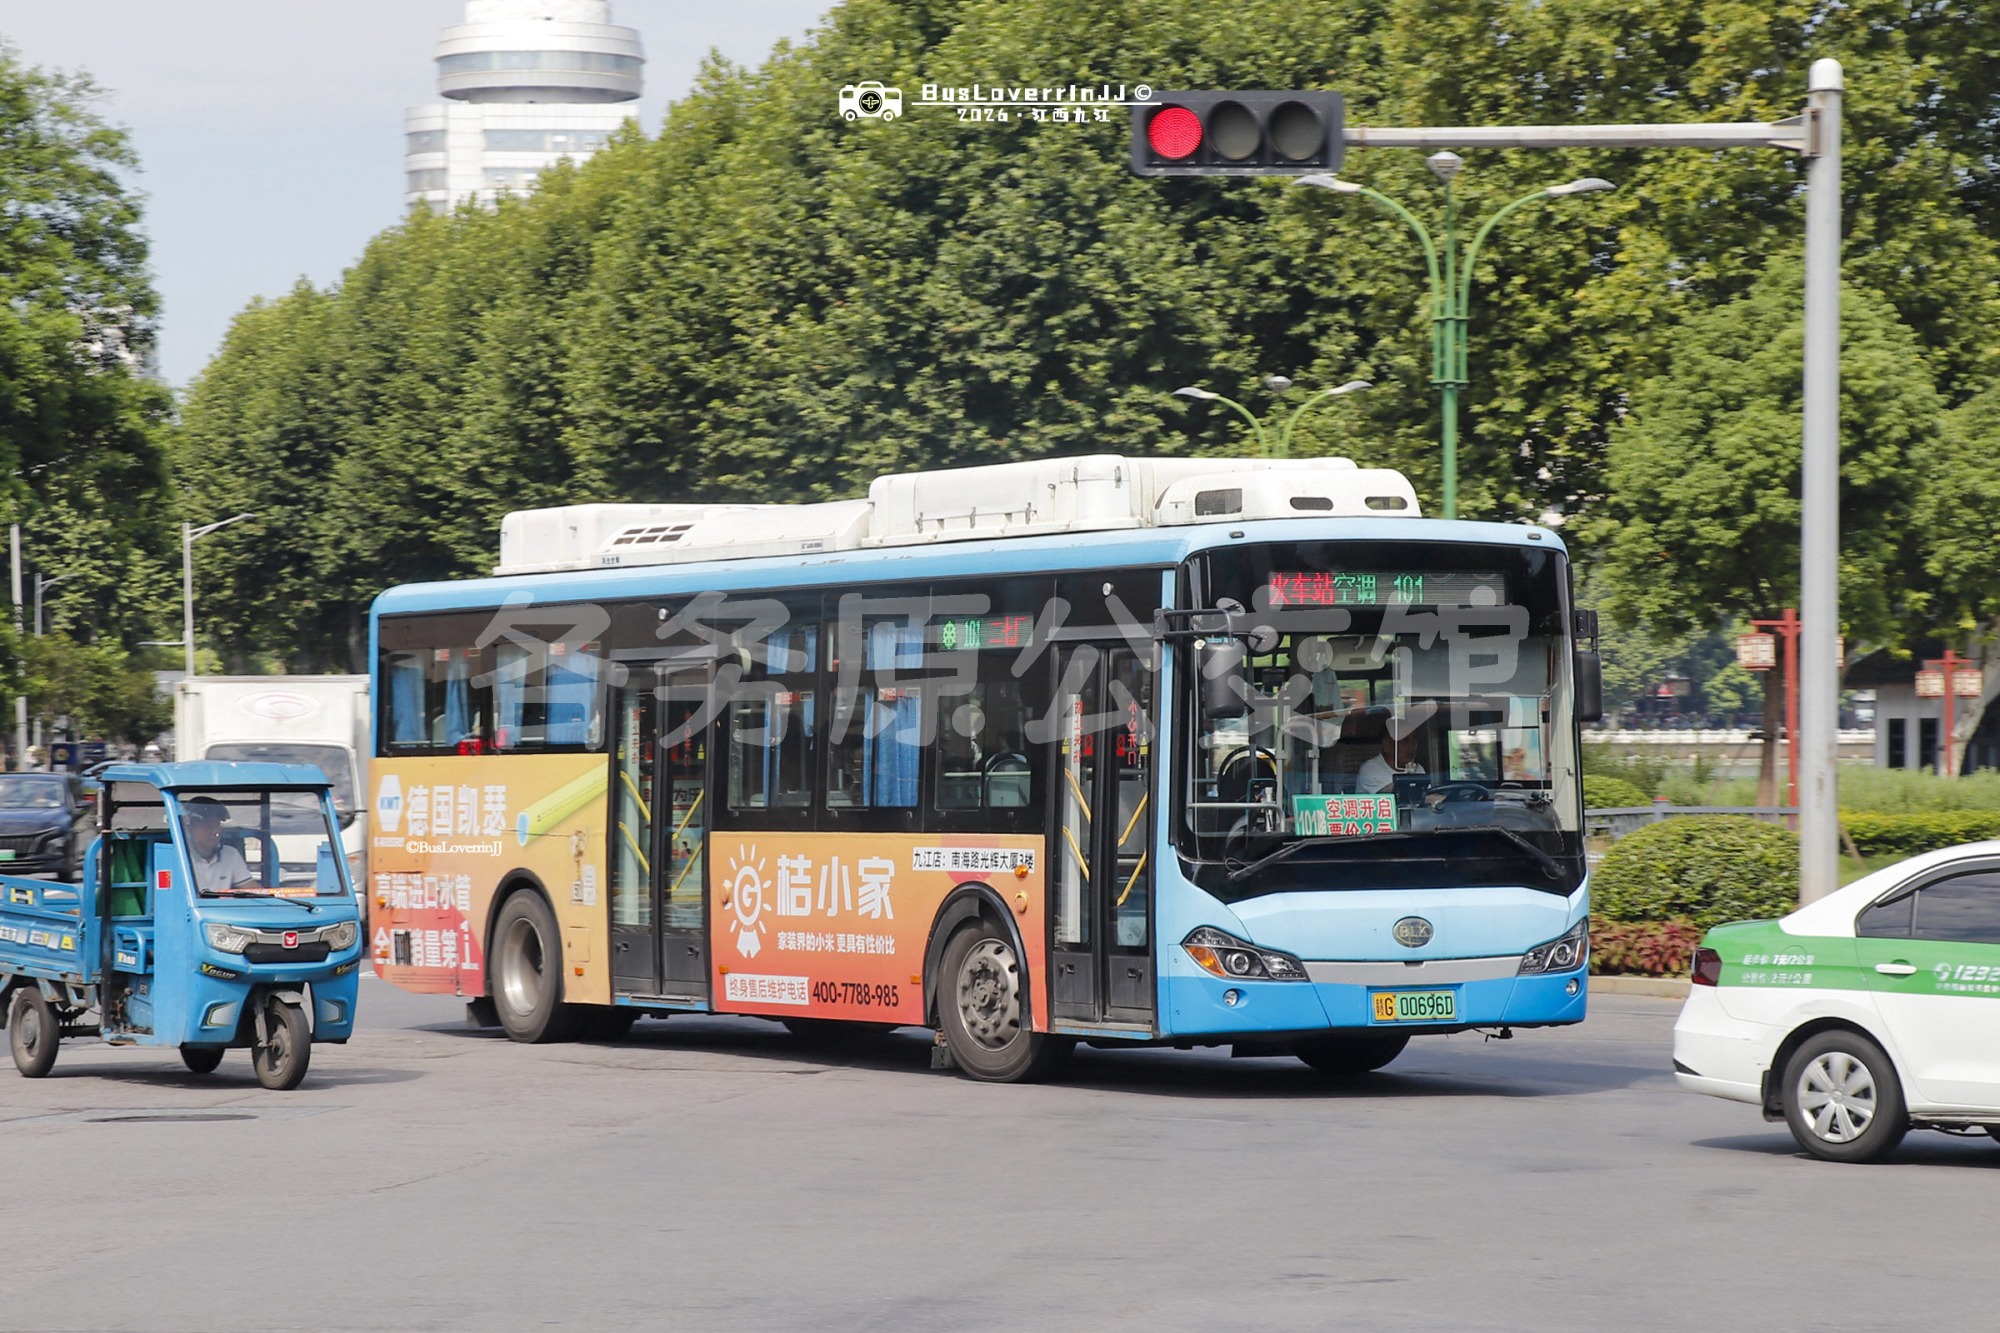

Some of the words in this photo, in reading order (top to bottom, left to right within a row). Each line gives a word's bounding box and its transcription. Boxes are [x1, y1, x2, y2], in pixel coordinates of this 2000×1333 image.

[1394, 574, 1424, 604] 101
[963, 620, 981, 647] 101
[1128, 701, 1138, 765] 小心开门
[405, 784, 508, 837] 德国凯瑟
[1326, 798, 1393, 819] 空调开启
[777, 854, 895, 920] 桔小家
[729, 977, 807, 1001] 终身售后维护电话
[812, 981, 899, 1007] 400-7788-985
